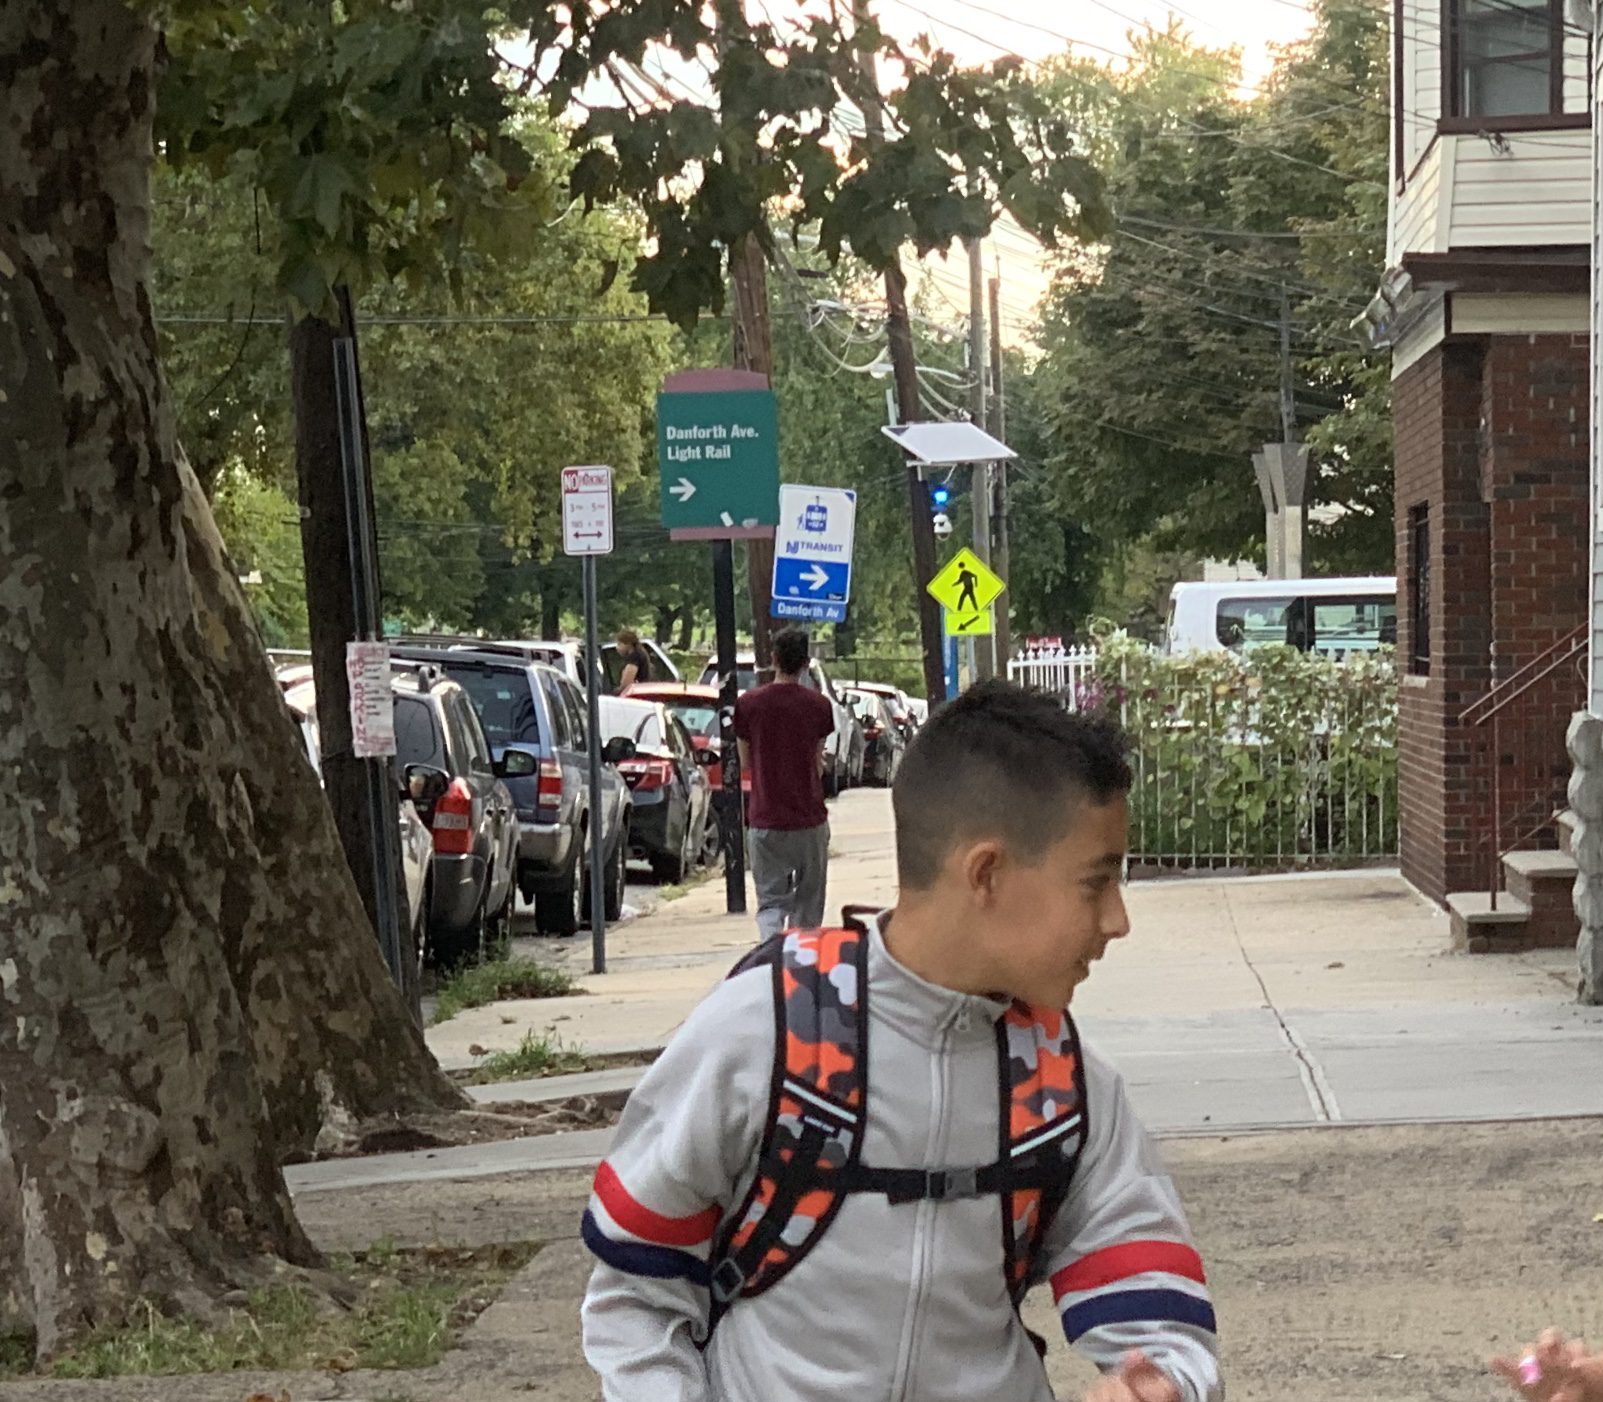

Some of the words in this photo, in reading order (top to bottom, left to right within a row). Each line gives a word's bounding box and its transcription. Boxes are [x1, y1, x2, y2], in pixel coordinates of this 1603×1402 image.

[666, 424, 726, 440] Danforth
[731, 424, 759, 438] Ave.
[667, 445, 702, 462] Light
[705, 445, 731, 459] Rail
[564, 473, 578, 491] NO
[801, 542, 844, 552] TRANSIT
[777, 602, 823, 617] Danforth
[826, 606, 840, 618] Av
